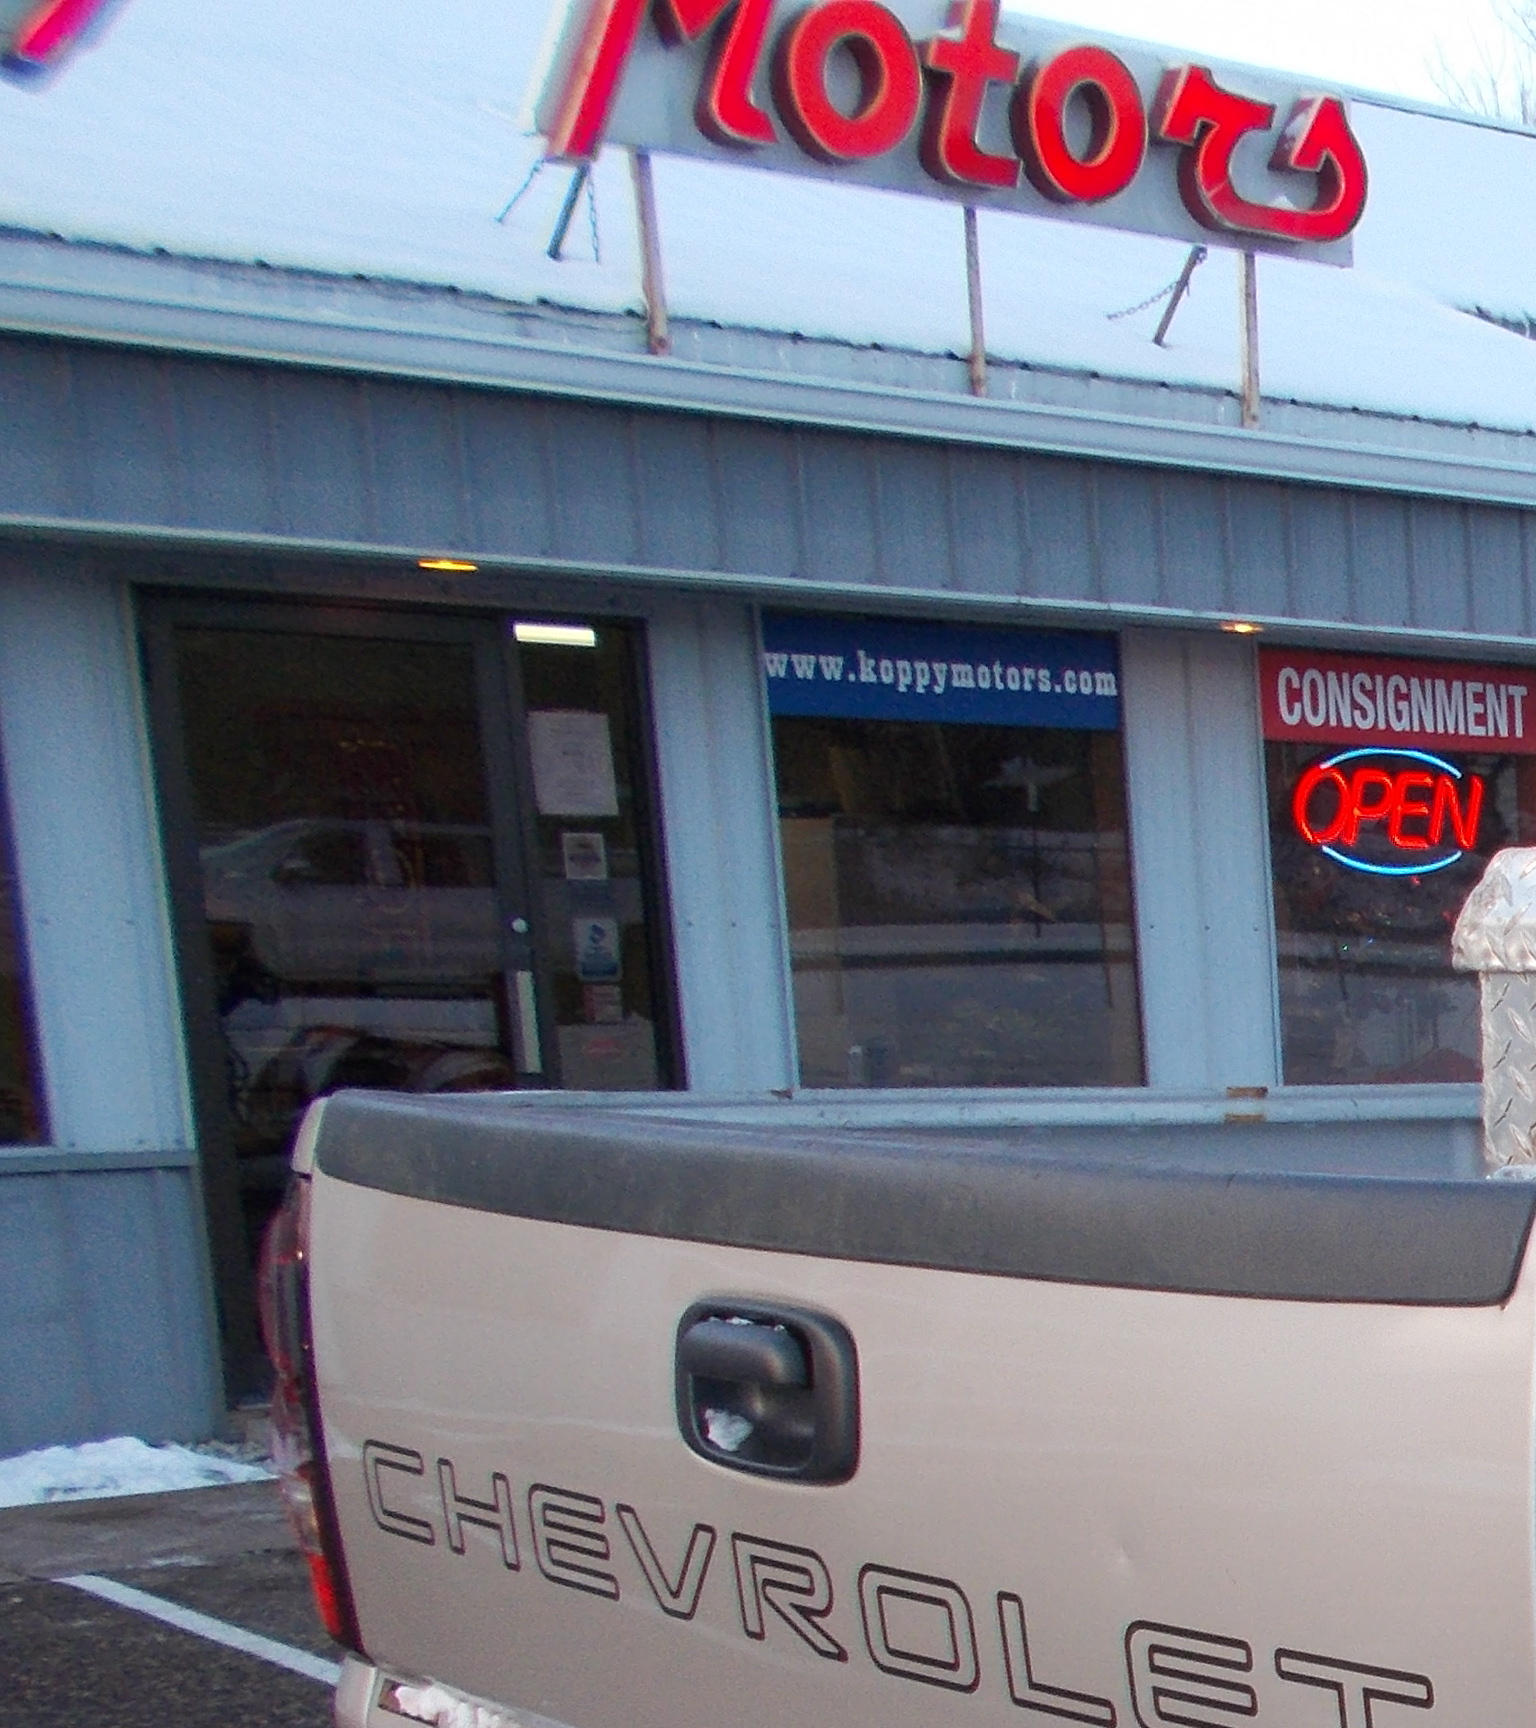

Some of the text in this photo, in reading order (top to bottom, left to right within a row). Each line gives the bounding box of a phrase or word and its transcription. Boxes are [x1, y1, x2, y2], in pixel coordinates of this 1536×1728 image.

[548, 0, 1368, 244] Motors
[764, 649, 1118, 696] www.koppymotors.com
[1277, 666, 1528, 738] CONSIGNMENT
[1293, 764, 1485, 850] OPEN
